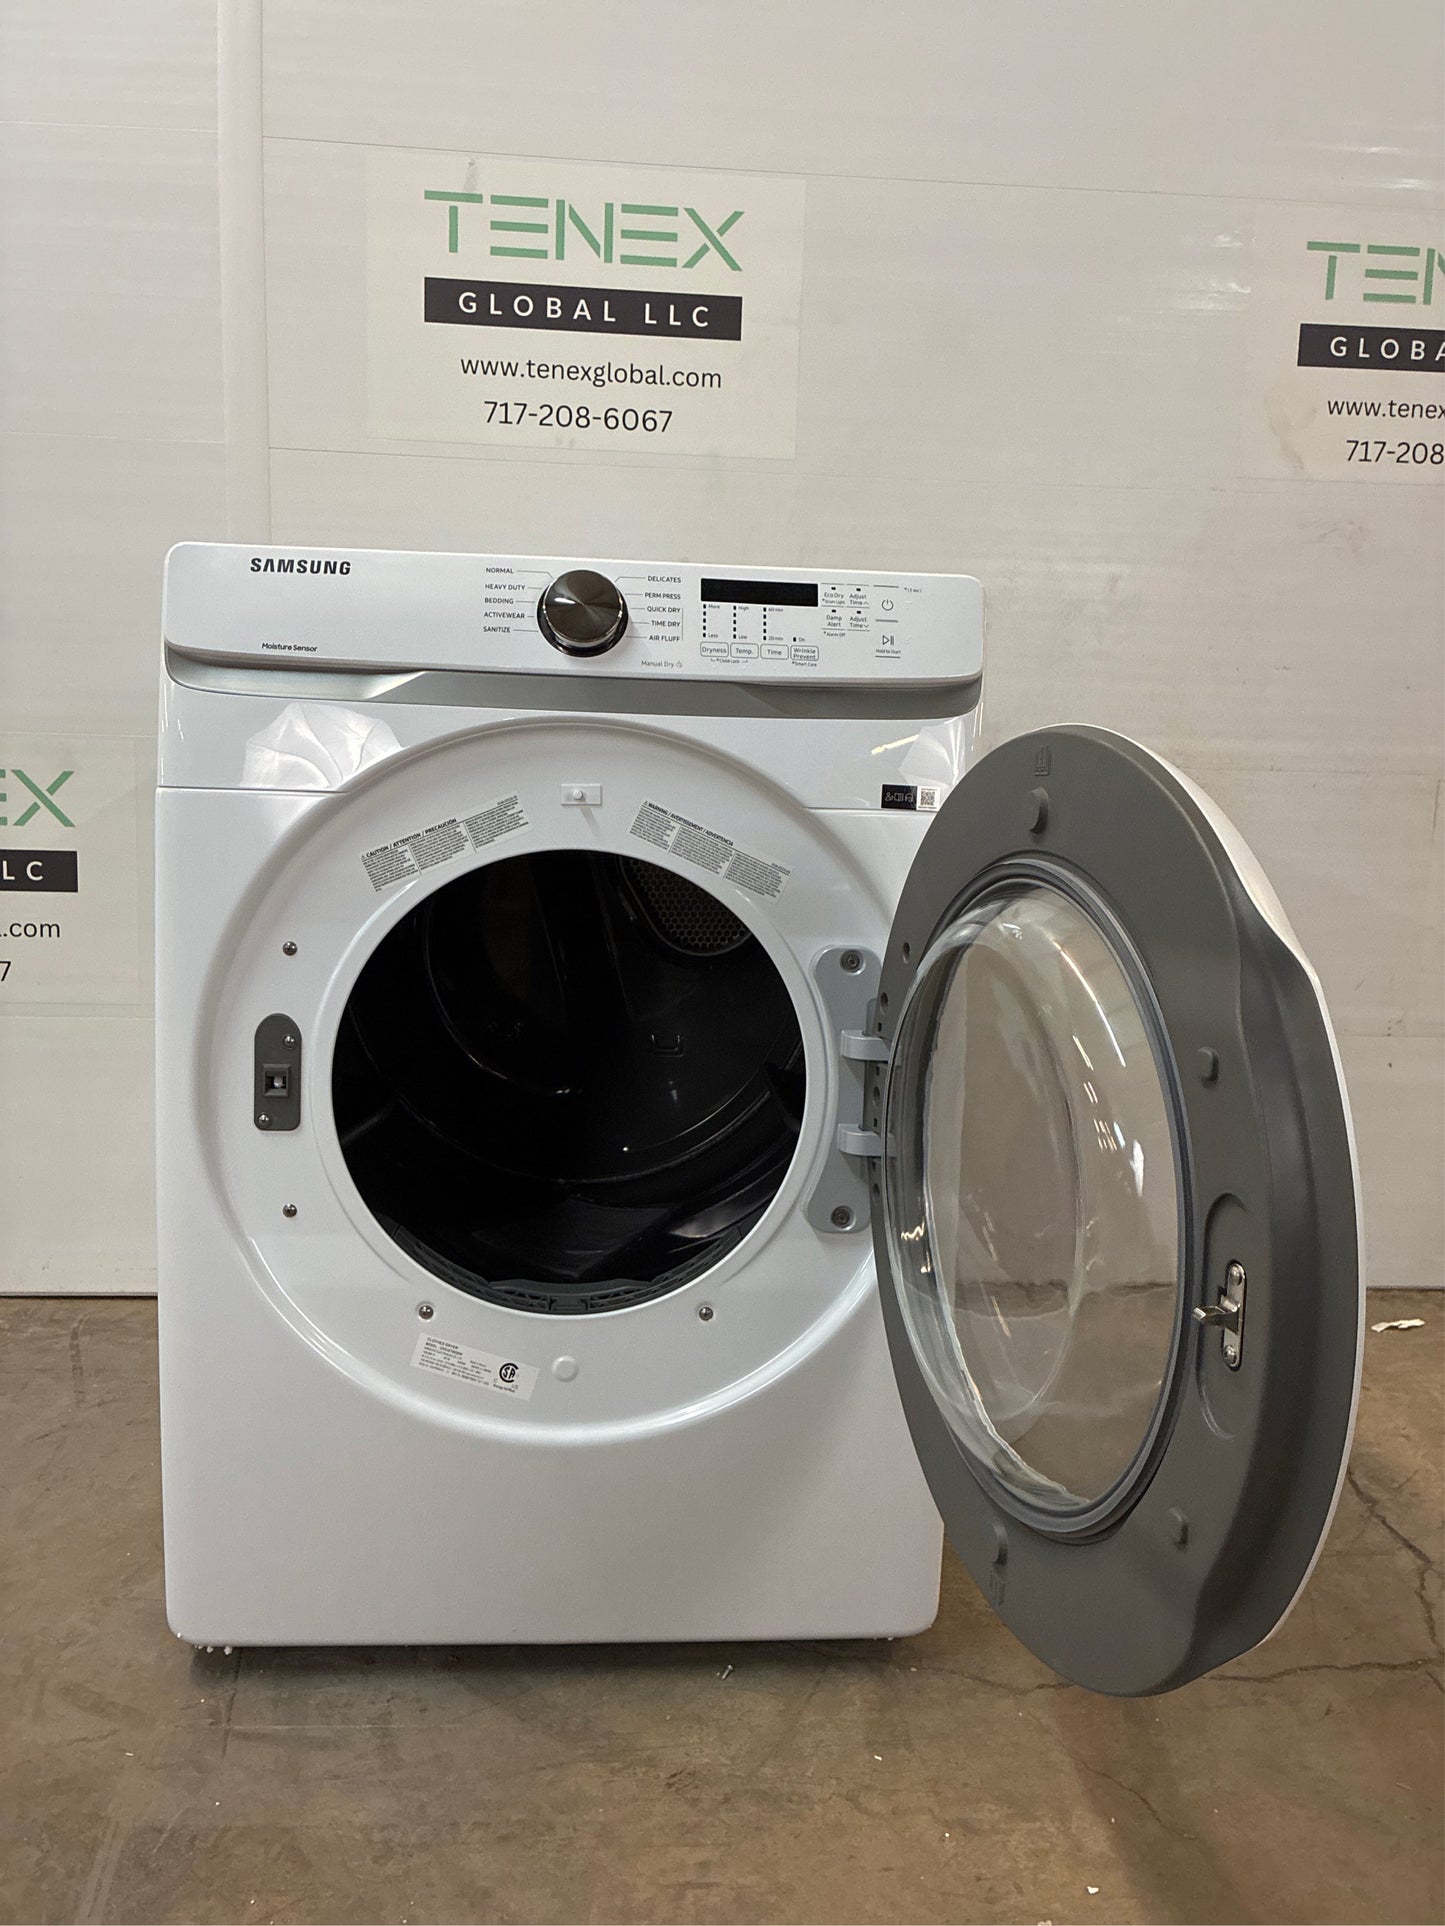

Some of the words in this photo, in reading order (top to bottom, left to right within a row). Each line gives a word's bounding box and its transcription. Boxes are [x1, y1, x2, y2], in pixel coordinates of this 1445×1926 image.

[424, 189, 745, 272] TENEX
[458, 291, 616, 323] GLOBAL
[644, 303, 710, 328] LLC
[460, 357, 722, 388] www.tenexglobal.com
[484, 401, 673, 433] 717-208-6067
[1346, 440, 1444, 464] 717-208
[250, 558, 350, 575] SAMSUNG
[262, 642, 292, 650] Moisture
[0, 768, 75, 828] X
[366, 845, 389, 858] CAUTION
[393, 832, 421, 847] ATTENTION
[425, 818, 457, 834] PRECAUCIÓN
